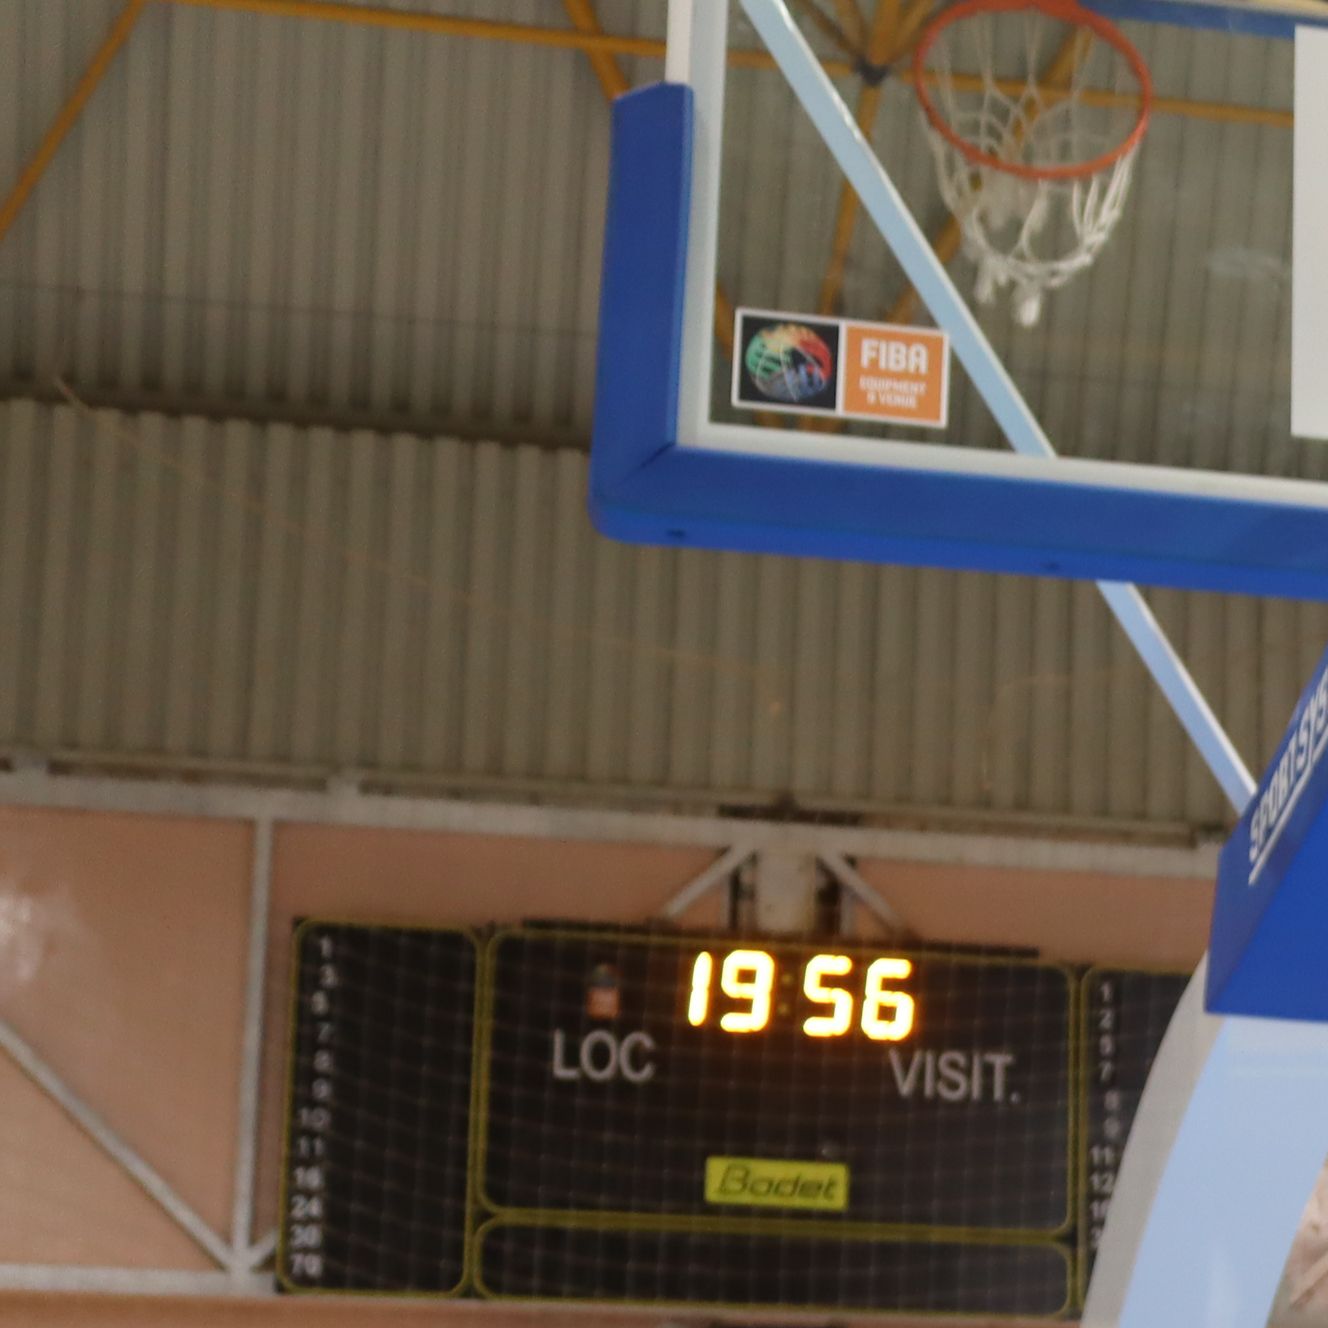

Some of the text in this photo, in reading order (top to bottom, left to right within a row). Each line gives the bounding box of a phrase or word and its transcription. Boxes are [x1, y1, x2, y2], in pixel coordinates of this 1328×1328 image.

[861, 338, 928, 375] FIBA
[552, 1029, 1021, 1103] LOC VISIT.
[718, 1162, 838, 1202] Bodet
